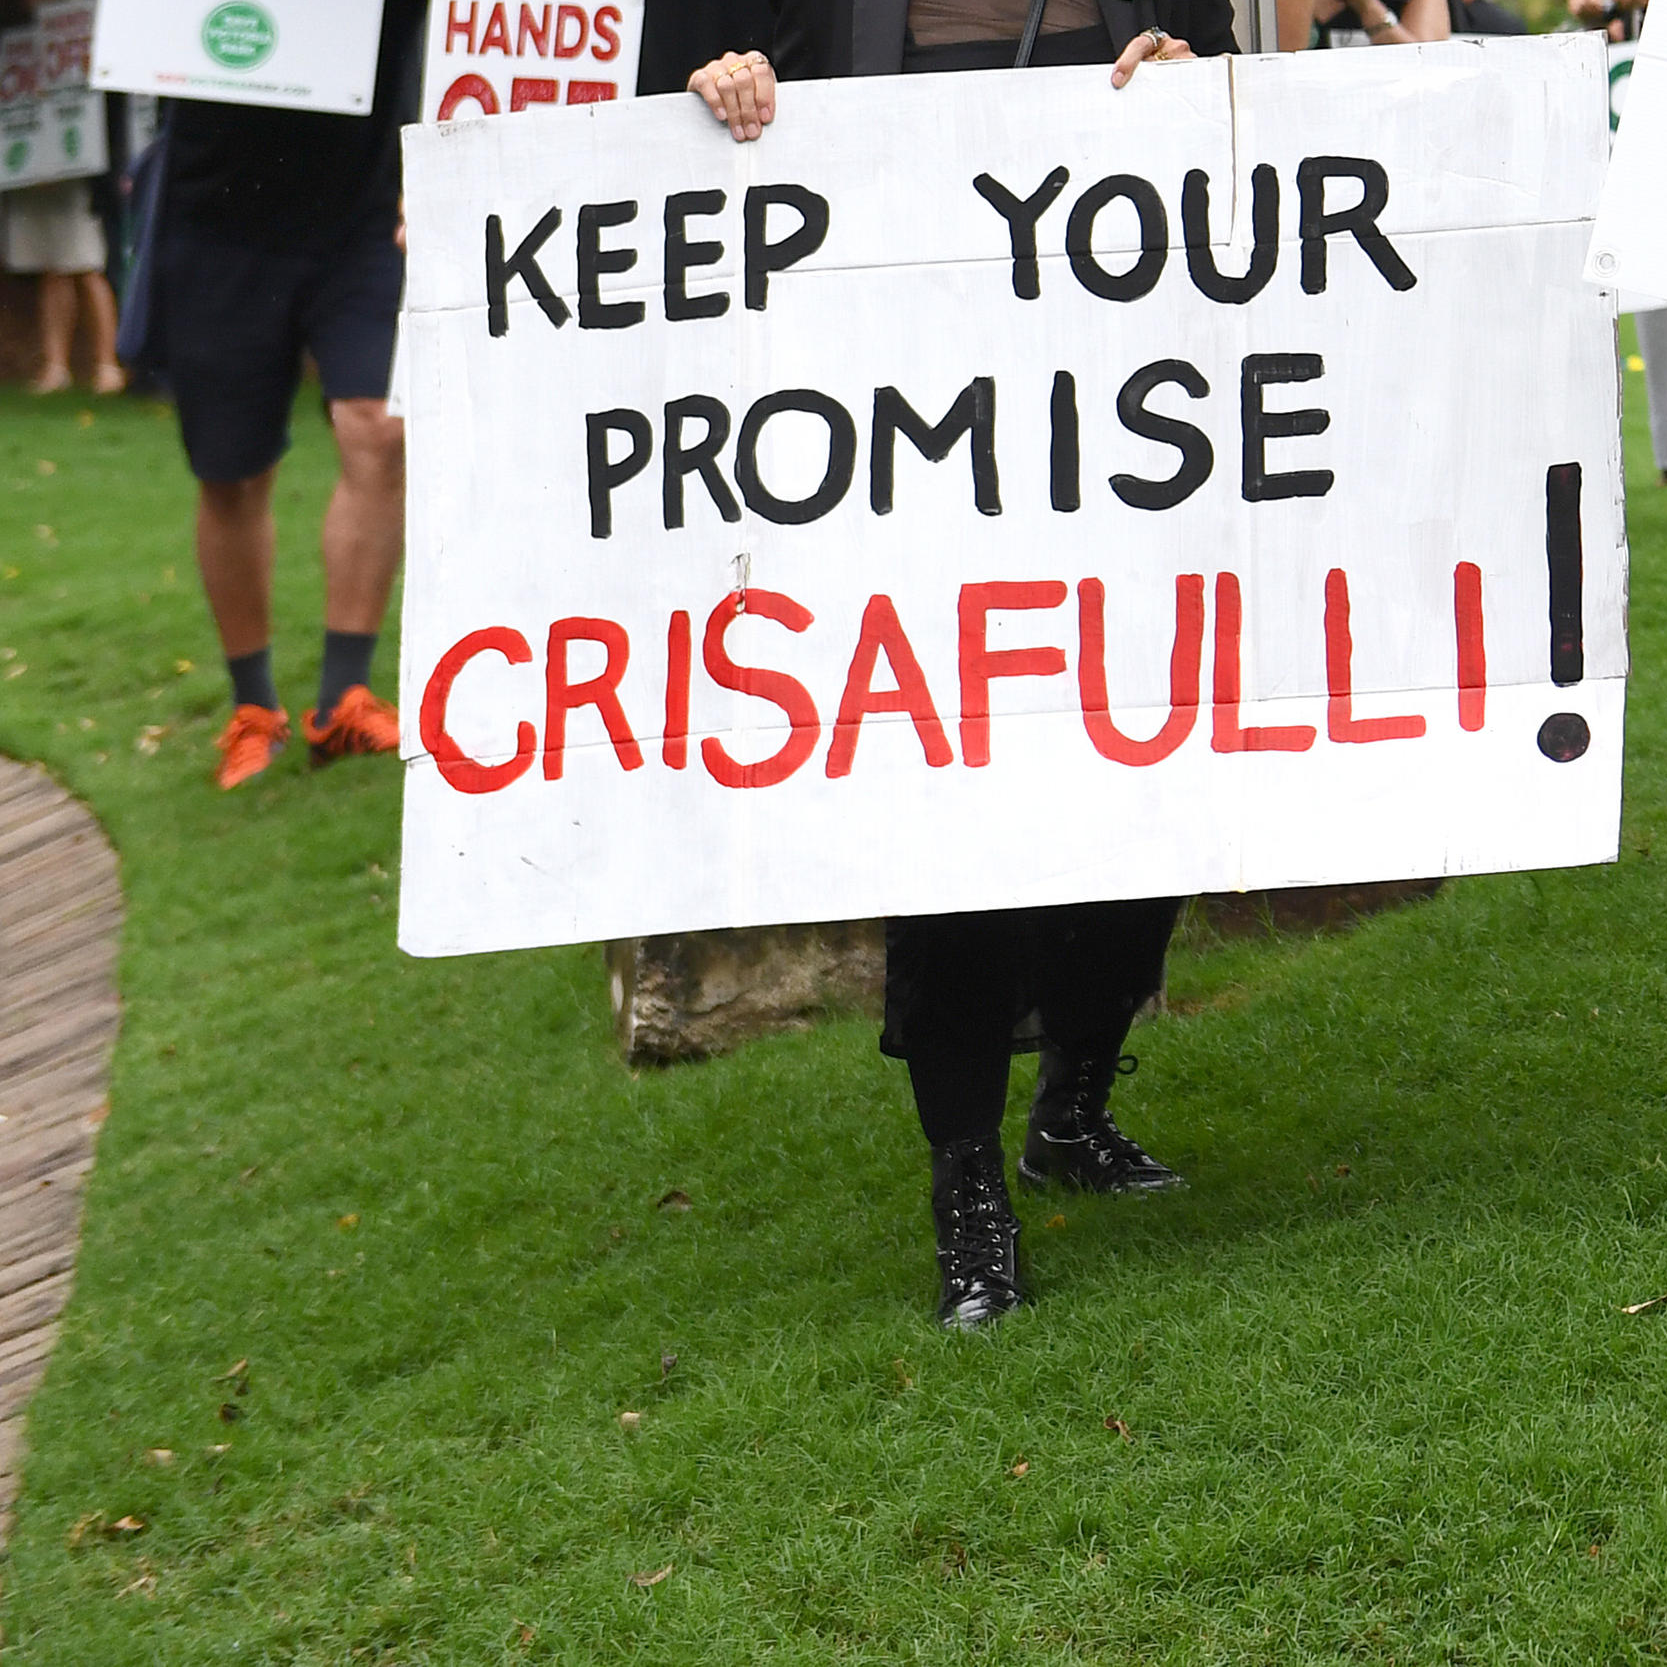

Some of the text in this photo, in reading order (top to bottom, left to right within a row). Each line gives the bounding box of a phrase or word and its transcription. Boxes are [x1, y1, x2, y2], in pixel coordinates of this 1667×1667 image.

[445, 1, 622, 61] HANDS
[485, 156, 1416, 337] KEEP YOUR
[585, 353, 1334, 539] PROMISE
